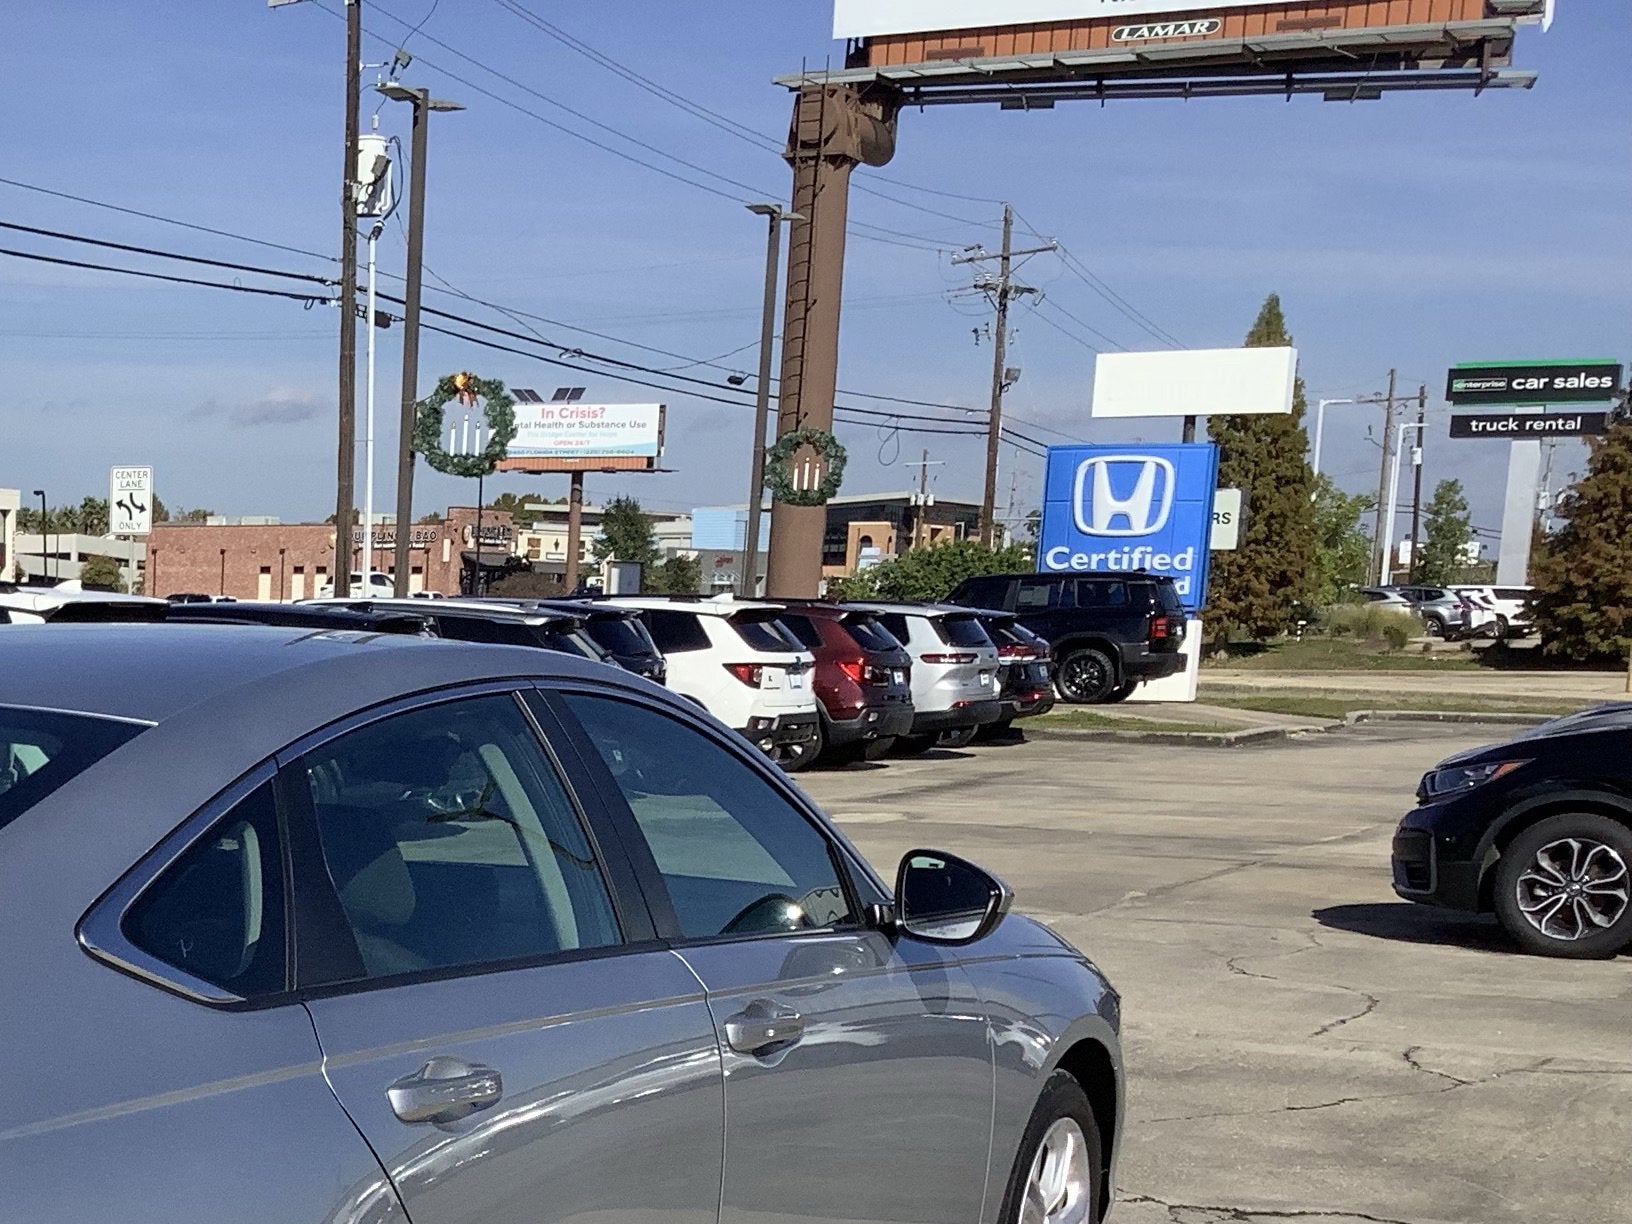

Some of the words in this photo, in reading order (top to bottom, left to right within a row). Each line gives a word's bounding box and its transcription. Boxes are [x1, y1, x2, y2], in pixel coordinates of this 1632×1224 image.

[1120, 21, 1210, 39] LAMAR
[1454, 380, 1507, 390] enterprise
[1512, 377, 1549, 390] car
[1553, 372, 1613, 389] sales
[541, 408, 554, 419] In
[559, 406, 606, 419] Crisis?
[515, 421, 532, 429] ntal
[534, 420, 565, 429] Health
[578, 420, 627, 429] Substance
[629, 420, 647, 429] Use
[1470, 417, 1519, 432] truck
[1525, 416, 1582, 431] rental
[115, 470, 149, 479] CENTER
[120, 480, 144, 488] LANE
[119, 521, 142, 530] ONLY
[415, 531, 437, 541] BAO
[1045, 545, 1194, 571] Certified
